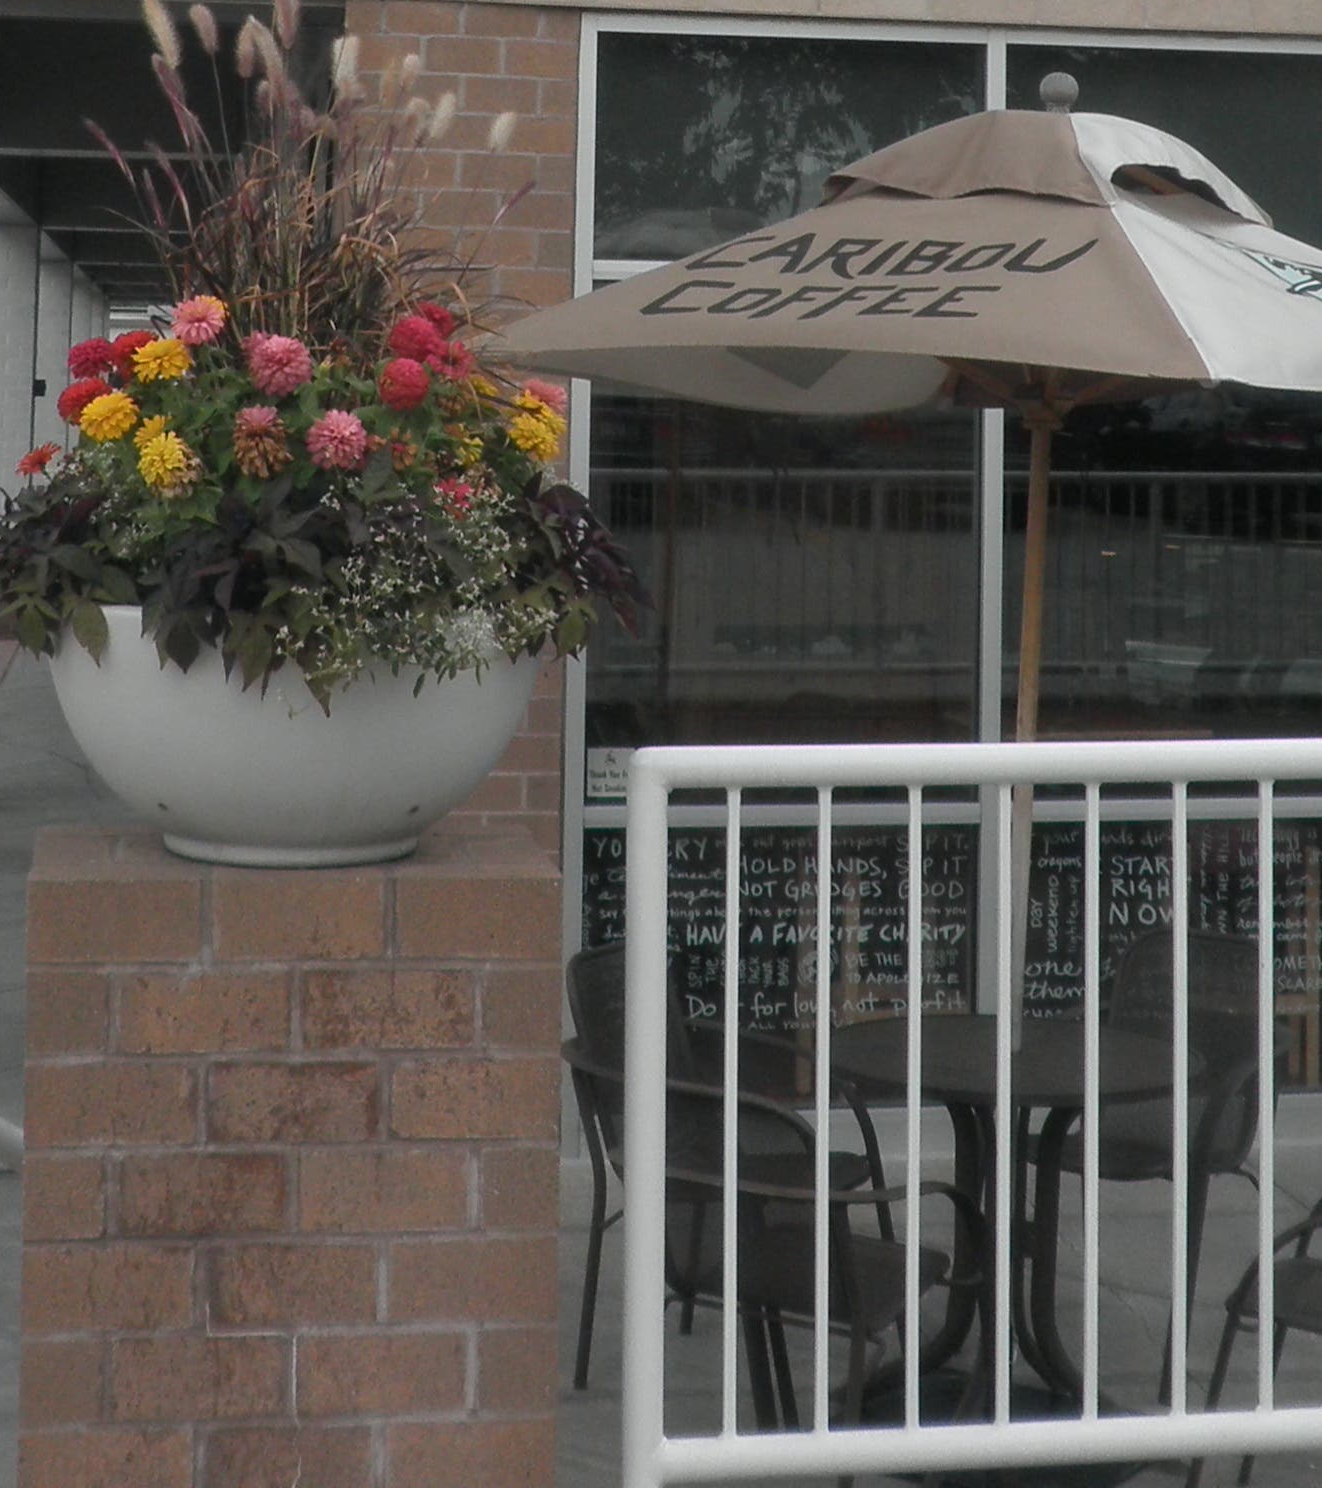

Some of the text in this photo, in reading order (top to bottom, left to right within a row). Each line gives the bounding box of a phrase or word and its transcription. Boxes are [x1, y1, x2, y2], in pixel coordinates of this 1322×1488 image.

[685, 232, 1099, 280] CARIBOU
[639, 279, 1001, 320] COFFEE
[895, 833, 936, 853] SP
[895, 856, 933, 876] SP
[1109, 855, 1172, 876] STAR
[784, 879, 882, 902] GRDGES
[1110, 878, 1170, 900] RIGH
[686, 923, 741, 946] HAV
[879, 921, 966, 945] CHRITY
[865, 971, 960, 985] APOLOIZE
[890, 990, 966, 1017] pofit
